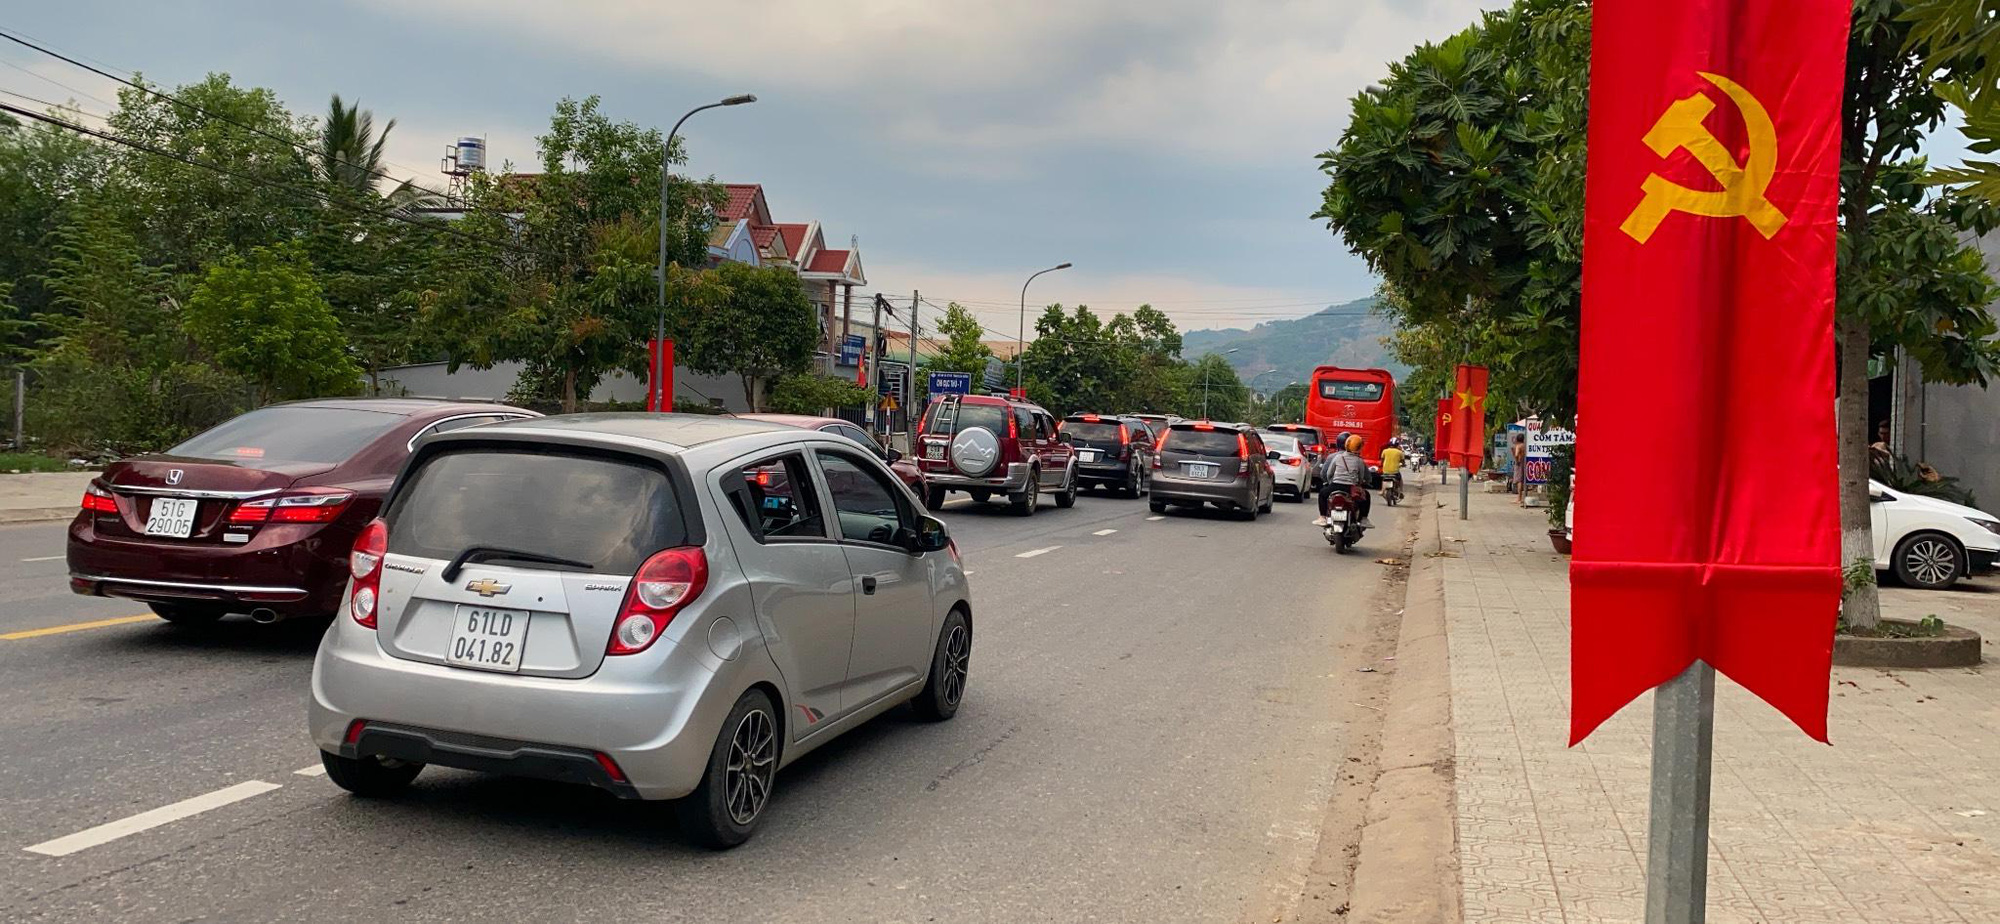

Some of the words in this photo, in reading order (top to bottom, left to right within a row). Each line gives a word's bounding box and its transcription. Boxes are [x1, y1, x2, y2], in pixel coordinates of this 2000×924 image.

[161, 501, 186, 517] 51G
[147, 517, 190, 535] 290.05
[467, 610, 513, 637] 61LD
[454, 637, 515, 666] 041.82
